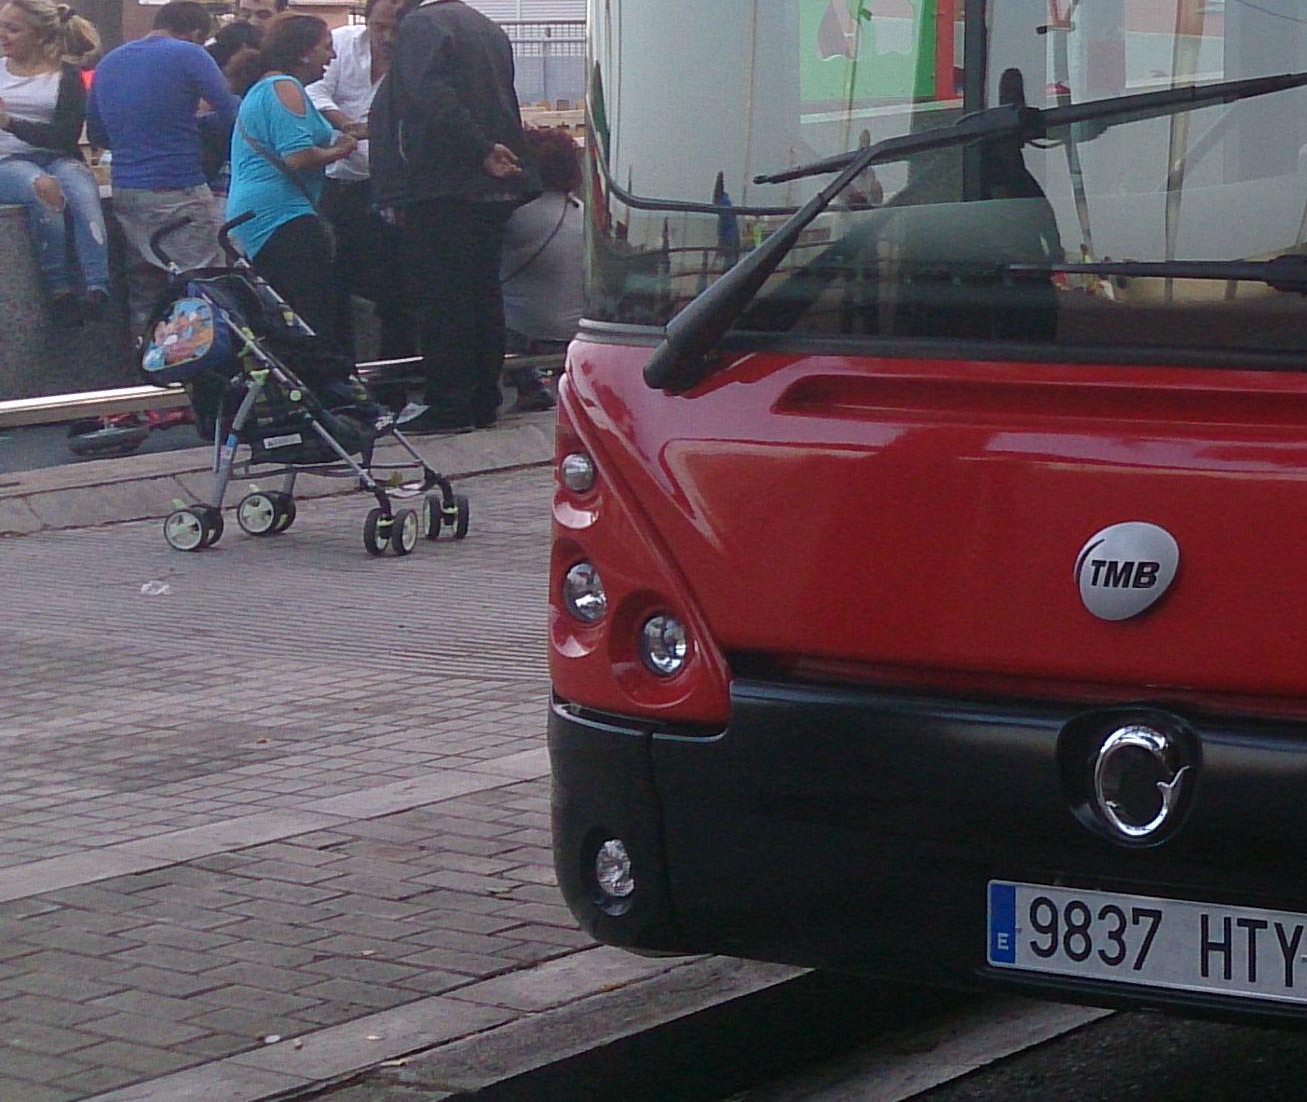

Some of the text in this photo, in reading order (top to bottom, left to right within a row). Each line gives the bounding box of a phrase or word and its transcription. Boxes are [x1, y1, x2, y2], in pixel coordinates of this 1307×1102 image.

[1091, 560, 1160, 588] TMB
[997, 897, 1304, 988] E 9837 HTY
